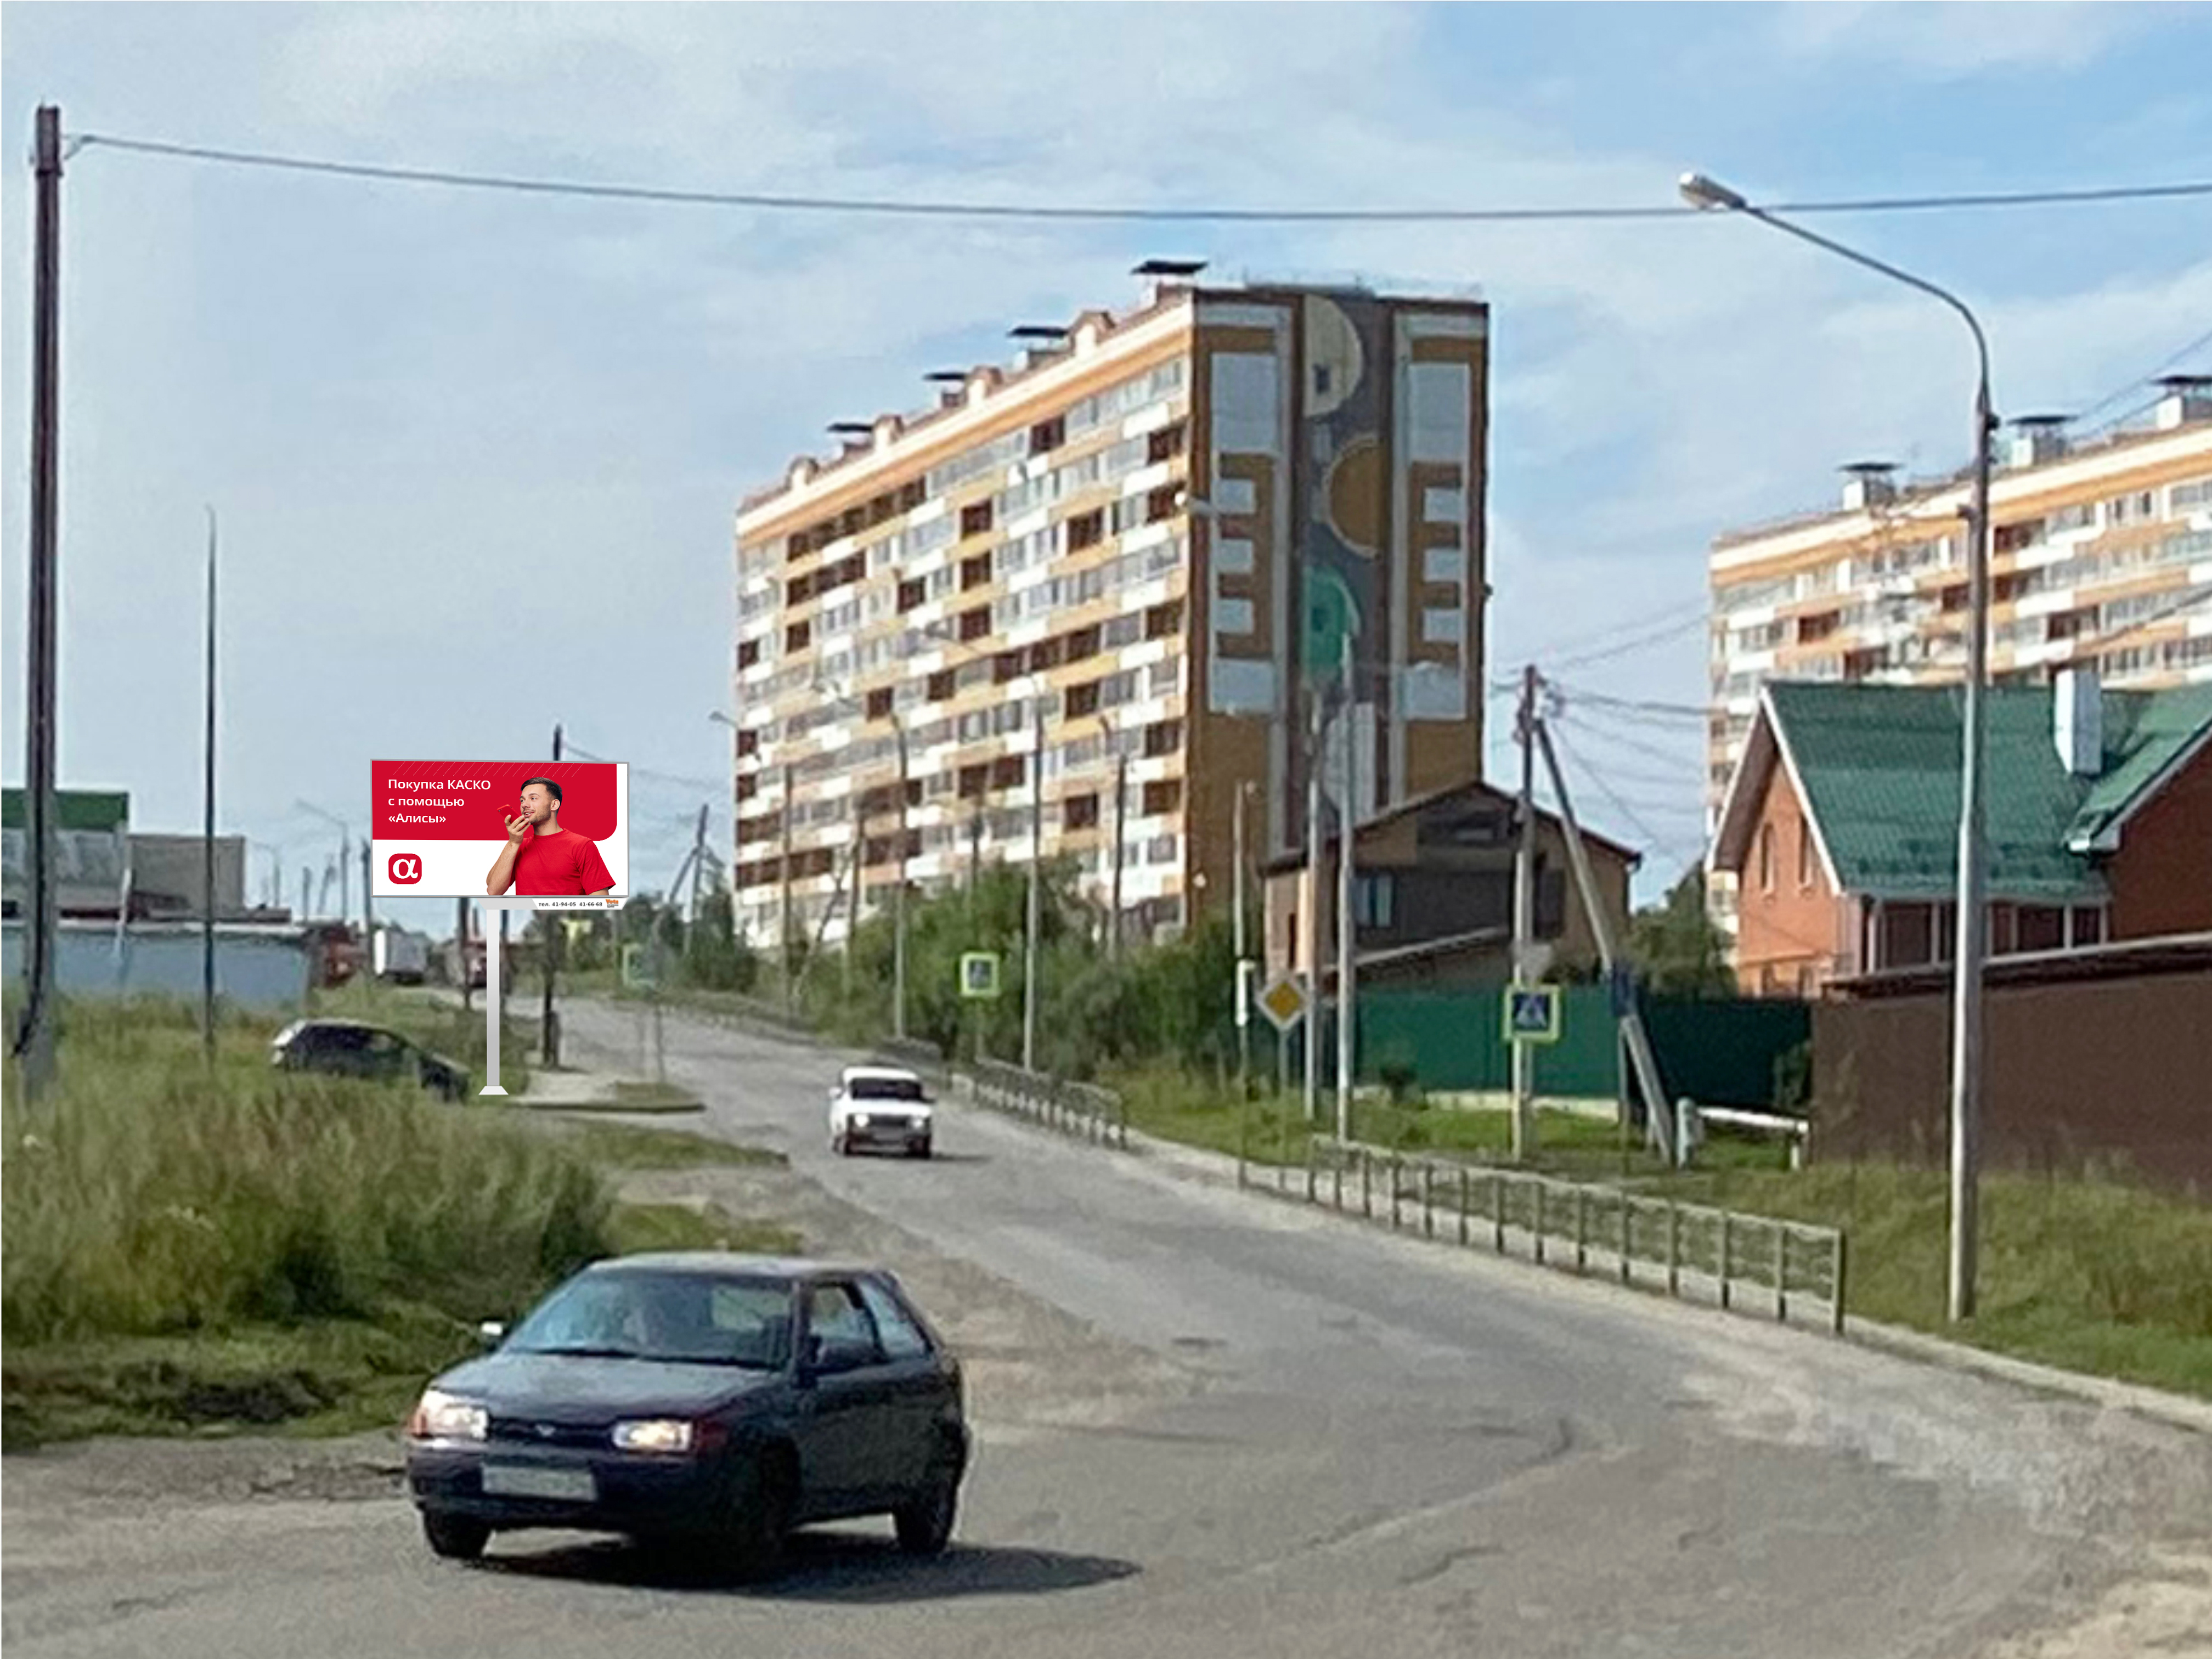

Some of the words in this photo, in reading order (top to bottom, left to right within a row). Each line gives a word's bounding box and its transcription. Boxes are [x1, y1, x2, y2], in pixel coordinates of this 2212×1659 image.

[388, 779, 444, 792] Покупка
[448, 780, 491, 790] КАСКО
[398, 798, 465, 809] помощью
[388, 813, 447, 823] «Алисы»
